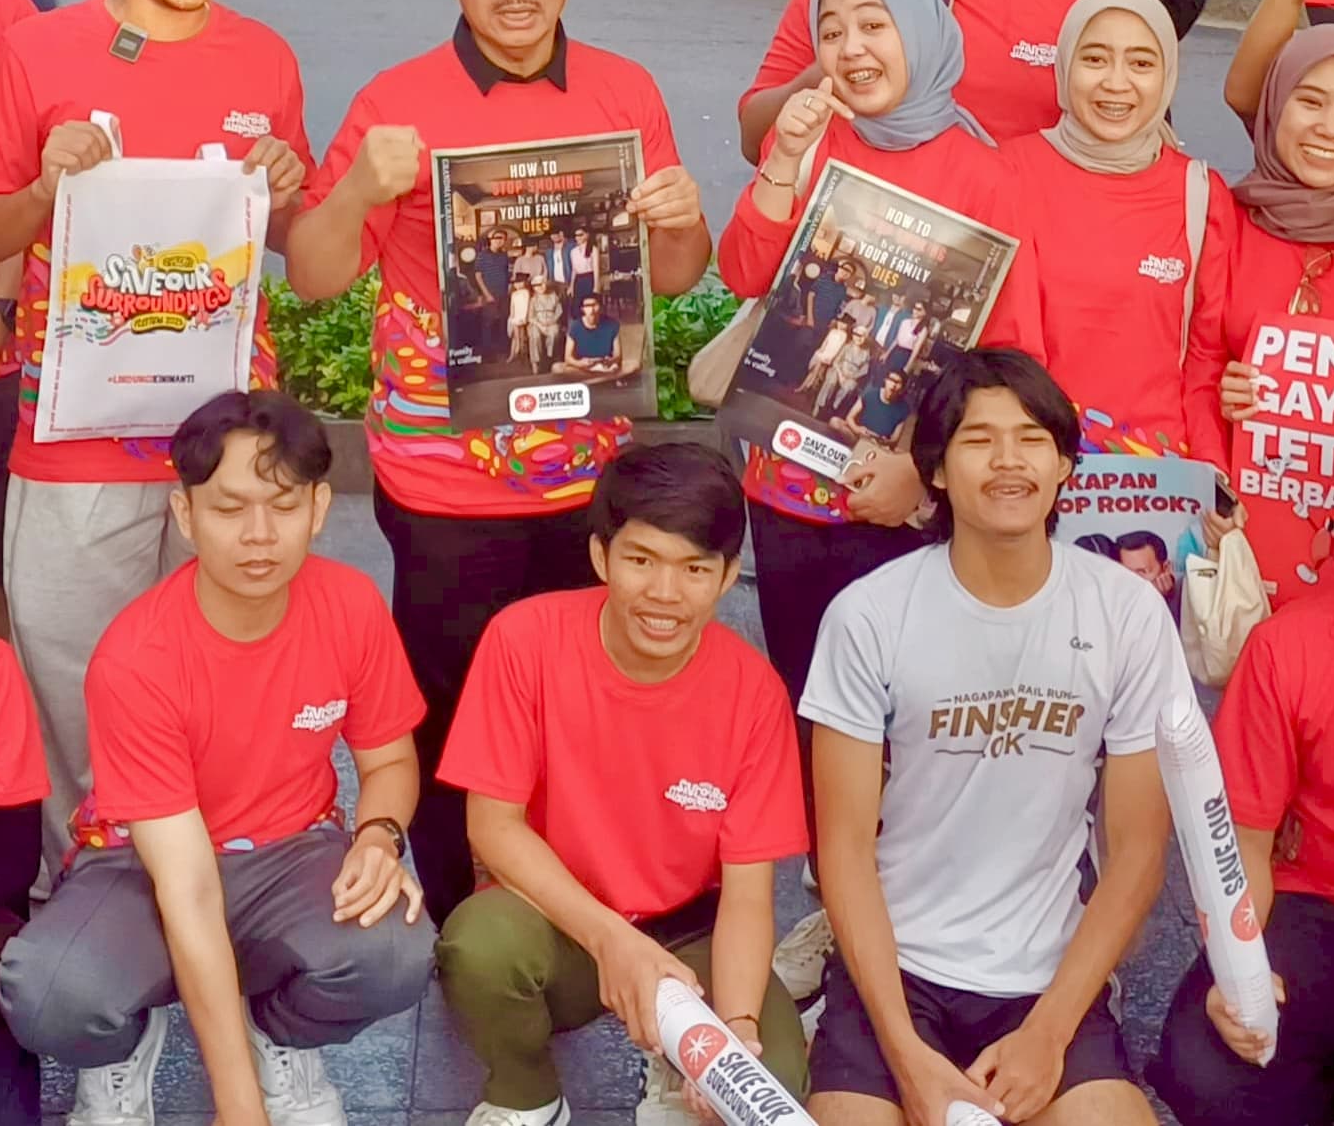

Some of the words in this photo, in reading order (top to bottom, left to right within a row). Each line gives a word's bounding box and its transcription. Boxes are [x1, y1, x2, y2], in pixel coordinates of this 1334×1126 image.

[510, 163, 538, 179] HOW
[543, 161, 558, 175] TO
[500, 204, 532, 220] YOUR
[535, 201, 577, 217] FAMILY
[522, 219, 550, 233] DIES
[915, 219, 931, 237] TO
[858, 241, 889, 265] YOUR
[890, 256, 932, 283] FAMILY
[103, 254, 166, 296] SAVE
[164, 262, 214, 292] OUR
[871, 265, 900, 288] DIES
[81, 268, 233, 319] SURROUNDINGS
[564, 390, 584, 400] OUR
[1067, 473, 1158, 491] KAPAN
[1055, 496, 1092, 515] OP
[1097, 495, 1202, 515] ROKOK?
[1018, 684, 1044, 698] RAIL
[1214, 841, 1245, 897] SAVE
[706, 1067, 770, 1126] SURROUNDIN
[718, 1052, 763, 1096] SAVE
[757, 1087, 796, 1124] OUR
